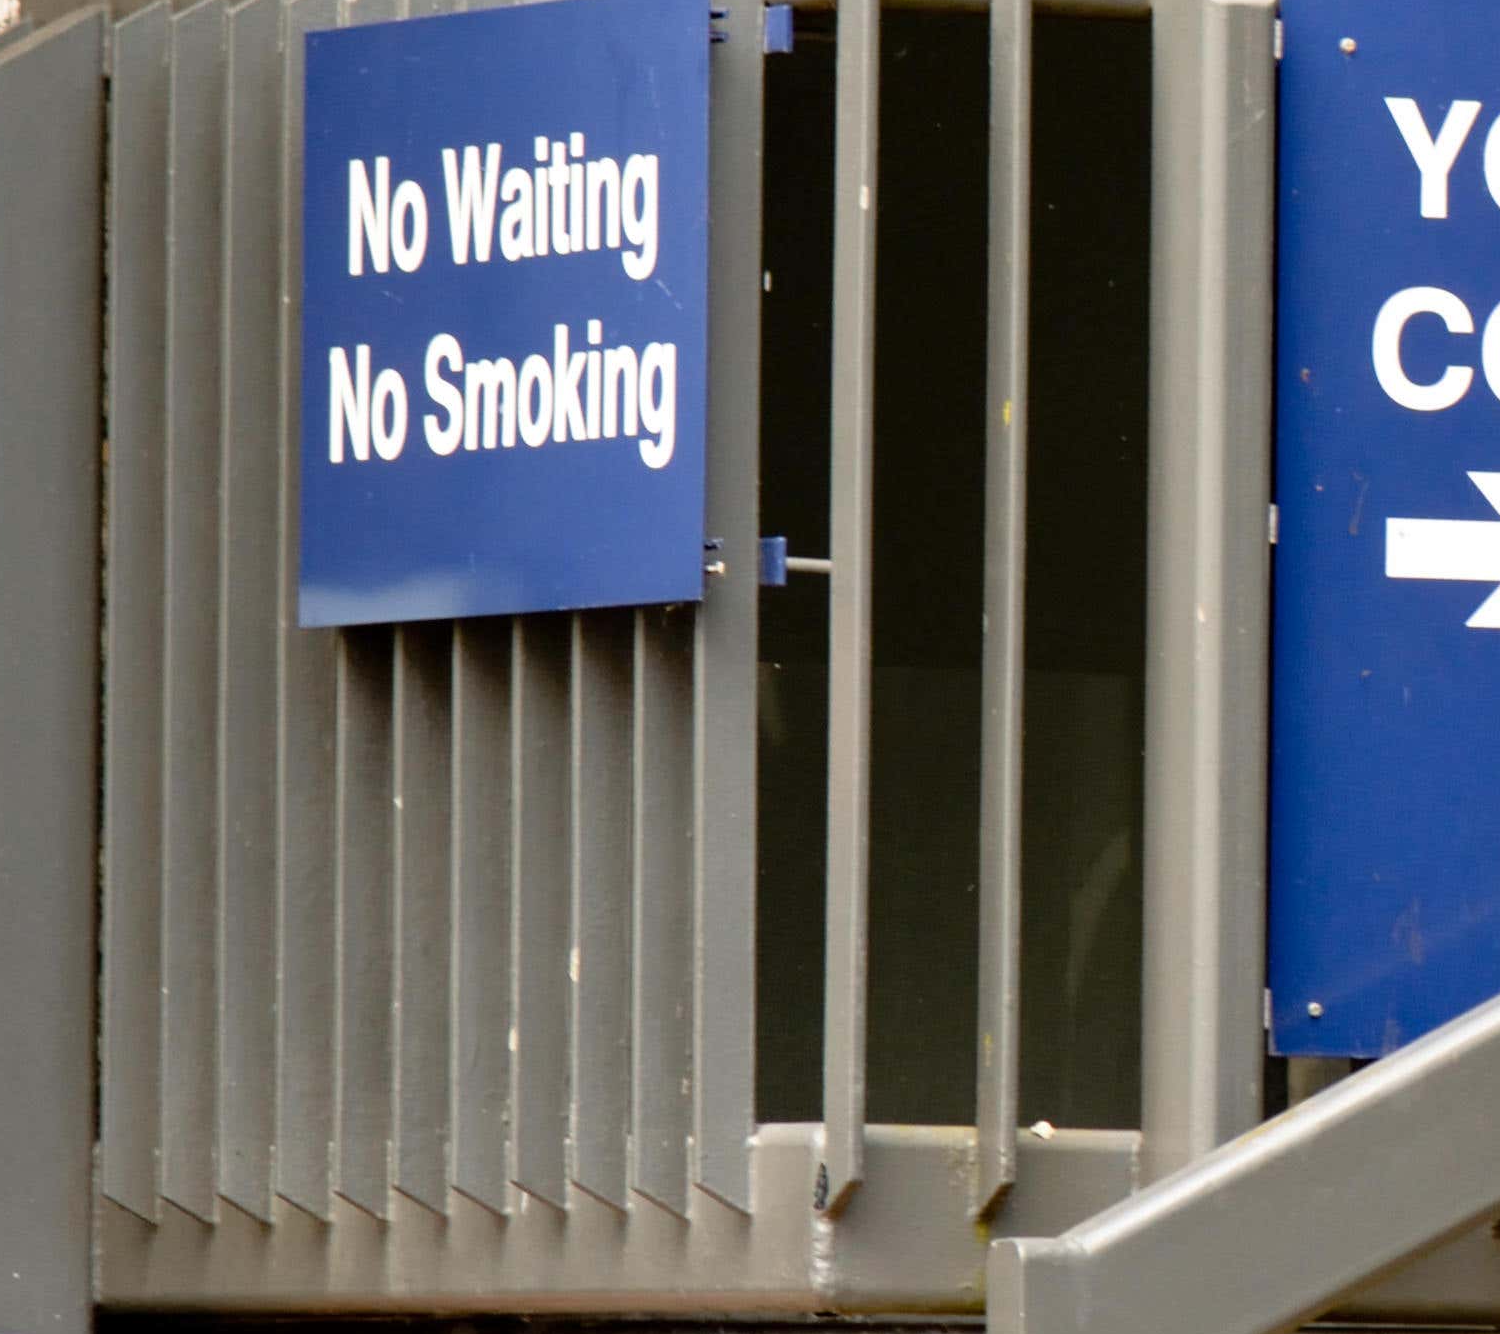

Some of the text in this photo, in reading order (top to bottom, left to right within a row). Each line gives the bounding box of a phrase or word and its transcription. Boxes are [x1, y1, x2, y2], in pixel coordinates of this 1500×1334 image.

[348, 131, 659, 281] No Waiting
[328, 319, 677, 469] No Smoking
